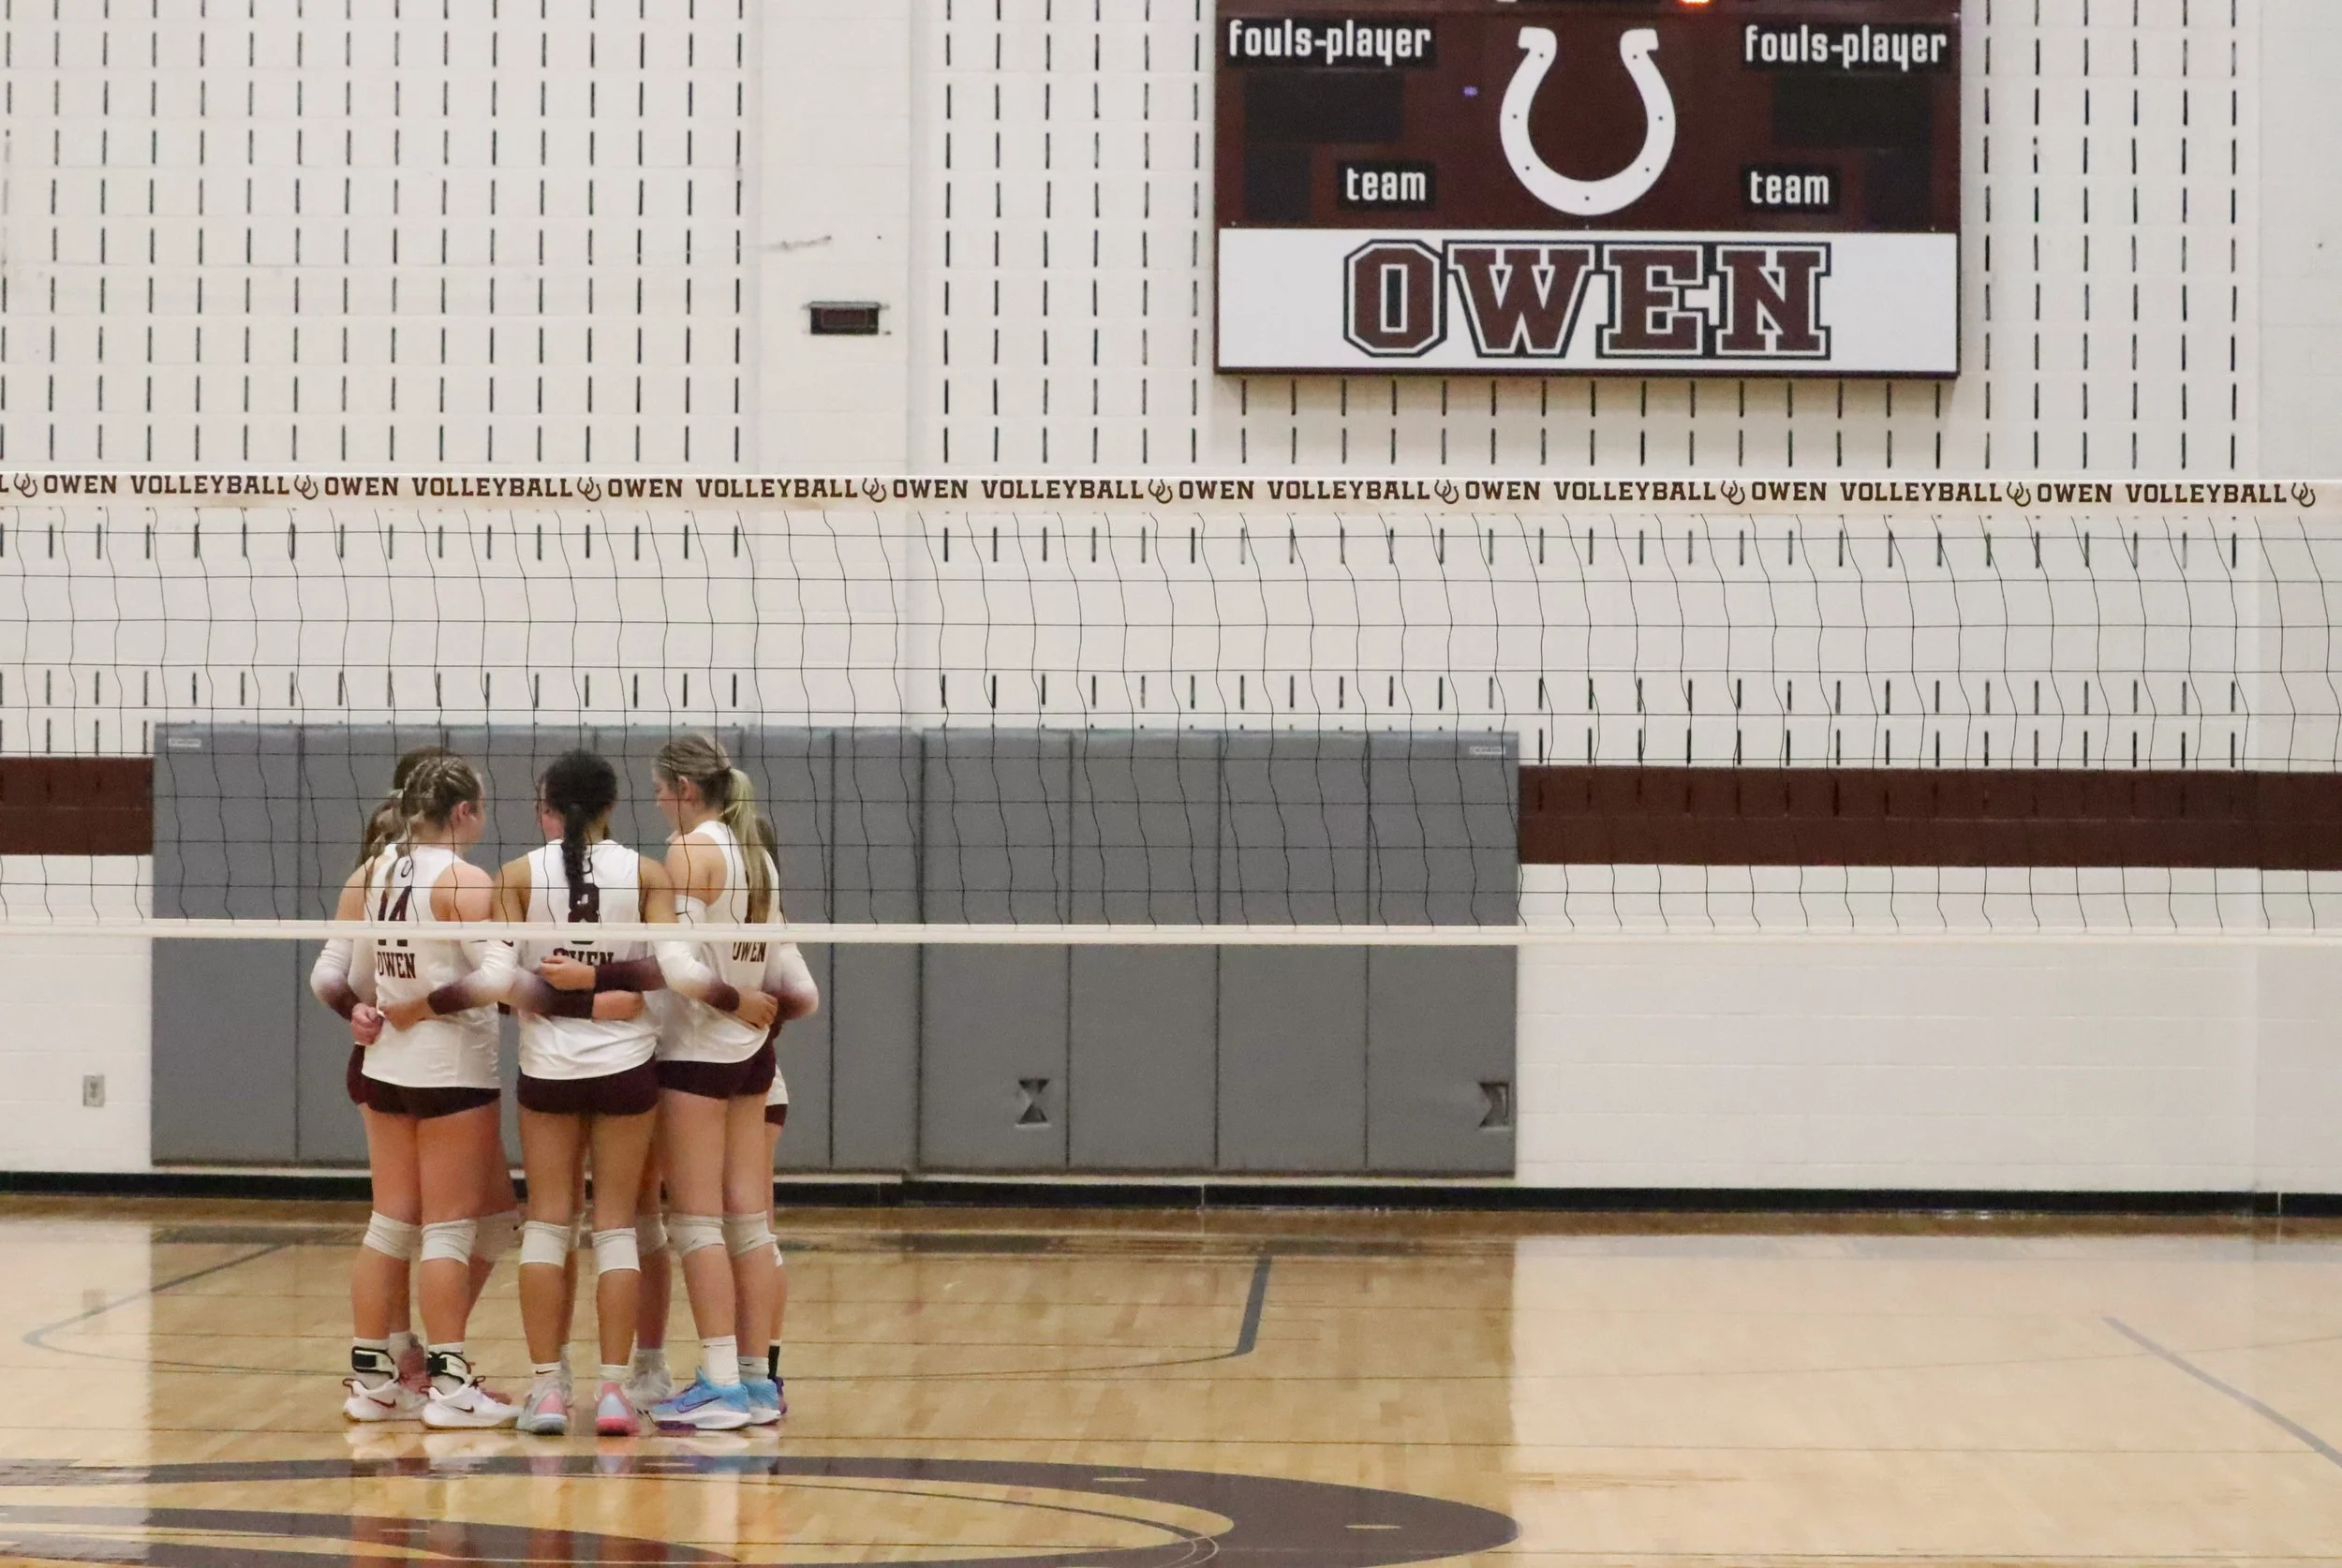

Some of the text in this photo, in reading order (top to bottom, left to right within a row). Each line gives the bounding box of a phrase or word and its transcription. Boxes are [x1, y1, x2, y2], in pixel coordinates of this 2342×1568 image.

[1229, 19, 1431, 66] fouls-player
[1744, 24, 1948, 70] fouls-player
[1346, 167, 1427, 201] team
[1750, 170, 1831, 205] team
[1343, 239, 1831, 360] OWEN
[44, 475, 2287, 504] OWEN VOLLEYBALL OWEN VOLLEYBALL OWEN VOLLEYBALL OWEN VOLLEYBALL OWEN VOLLEYBALL OWEN VOLLEYBALL OWEN VOLLEYBALL OWEN VOLLEYBALL
[377, 951, 416, 980] OWEN
